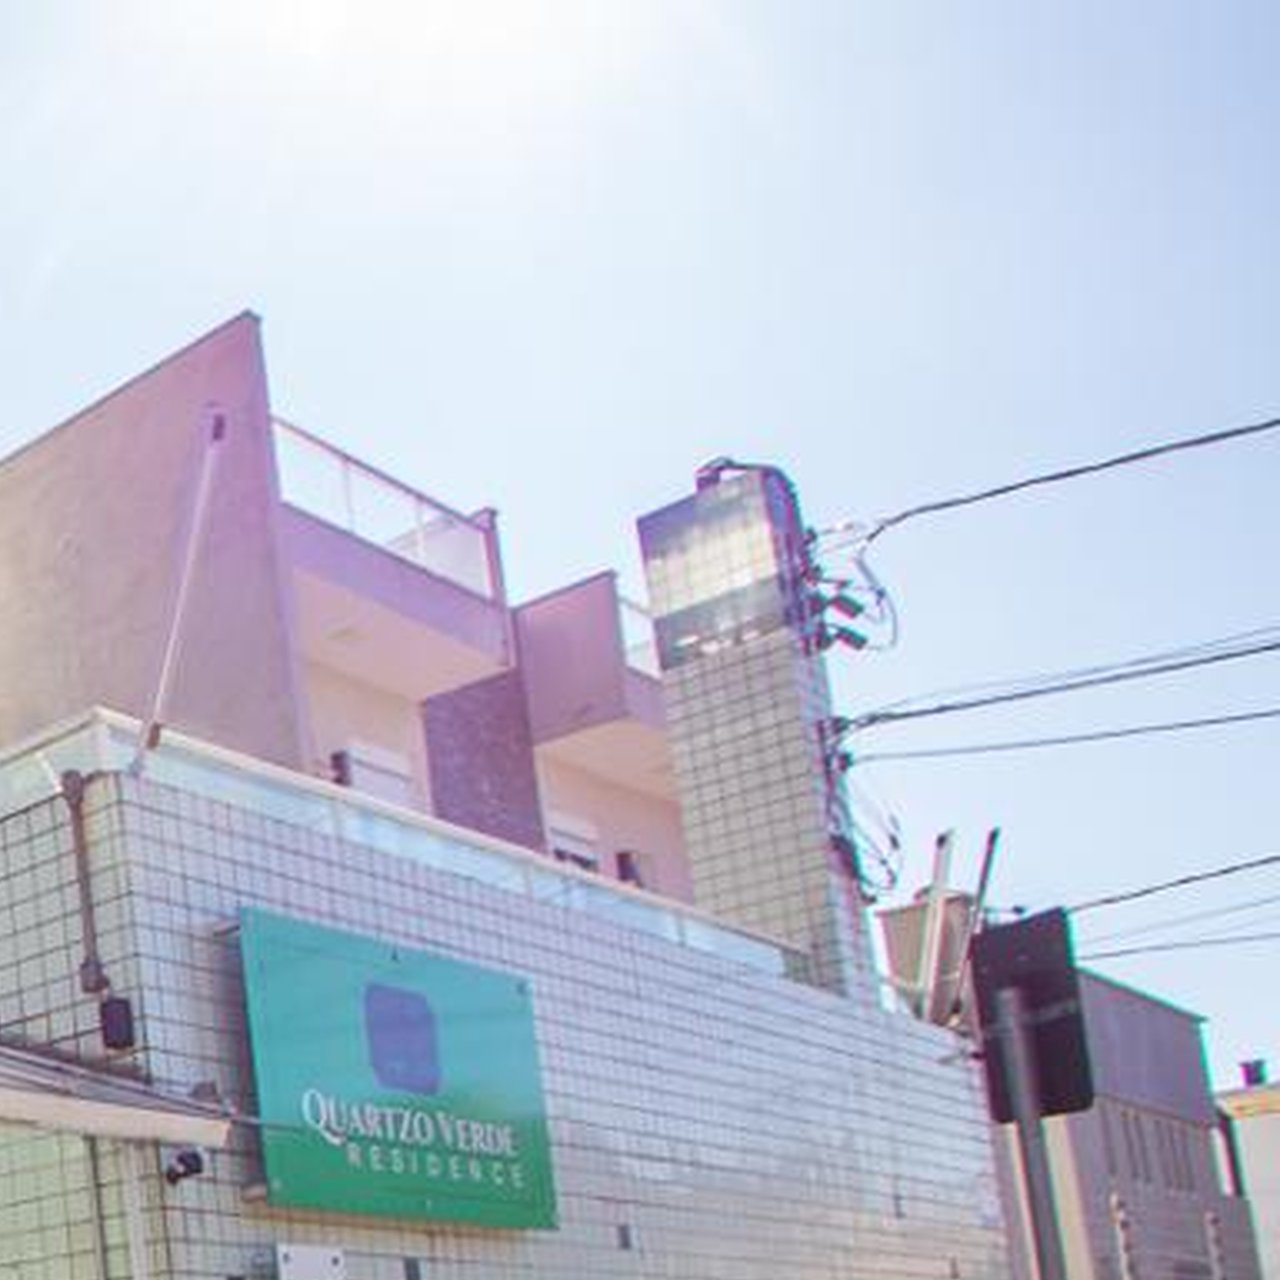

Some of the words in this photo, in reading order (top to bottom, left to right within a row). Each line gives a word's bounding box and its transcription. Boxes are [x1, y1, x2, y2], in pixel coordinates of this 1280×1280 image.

[302, 1089, 433, 1145] QUARTZO
[438, 1112, 517, 1156] VERDE
[347, 1144, 525, 1189] RESIDENCE
